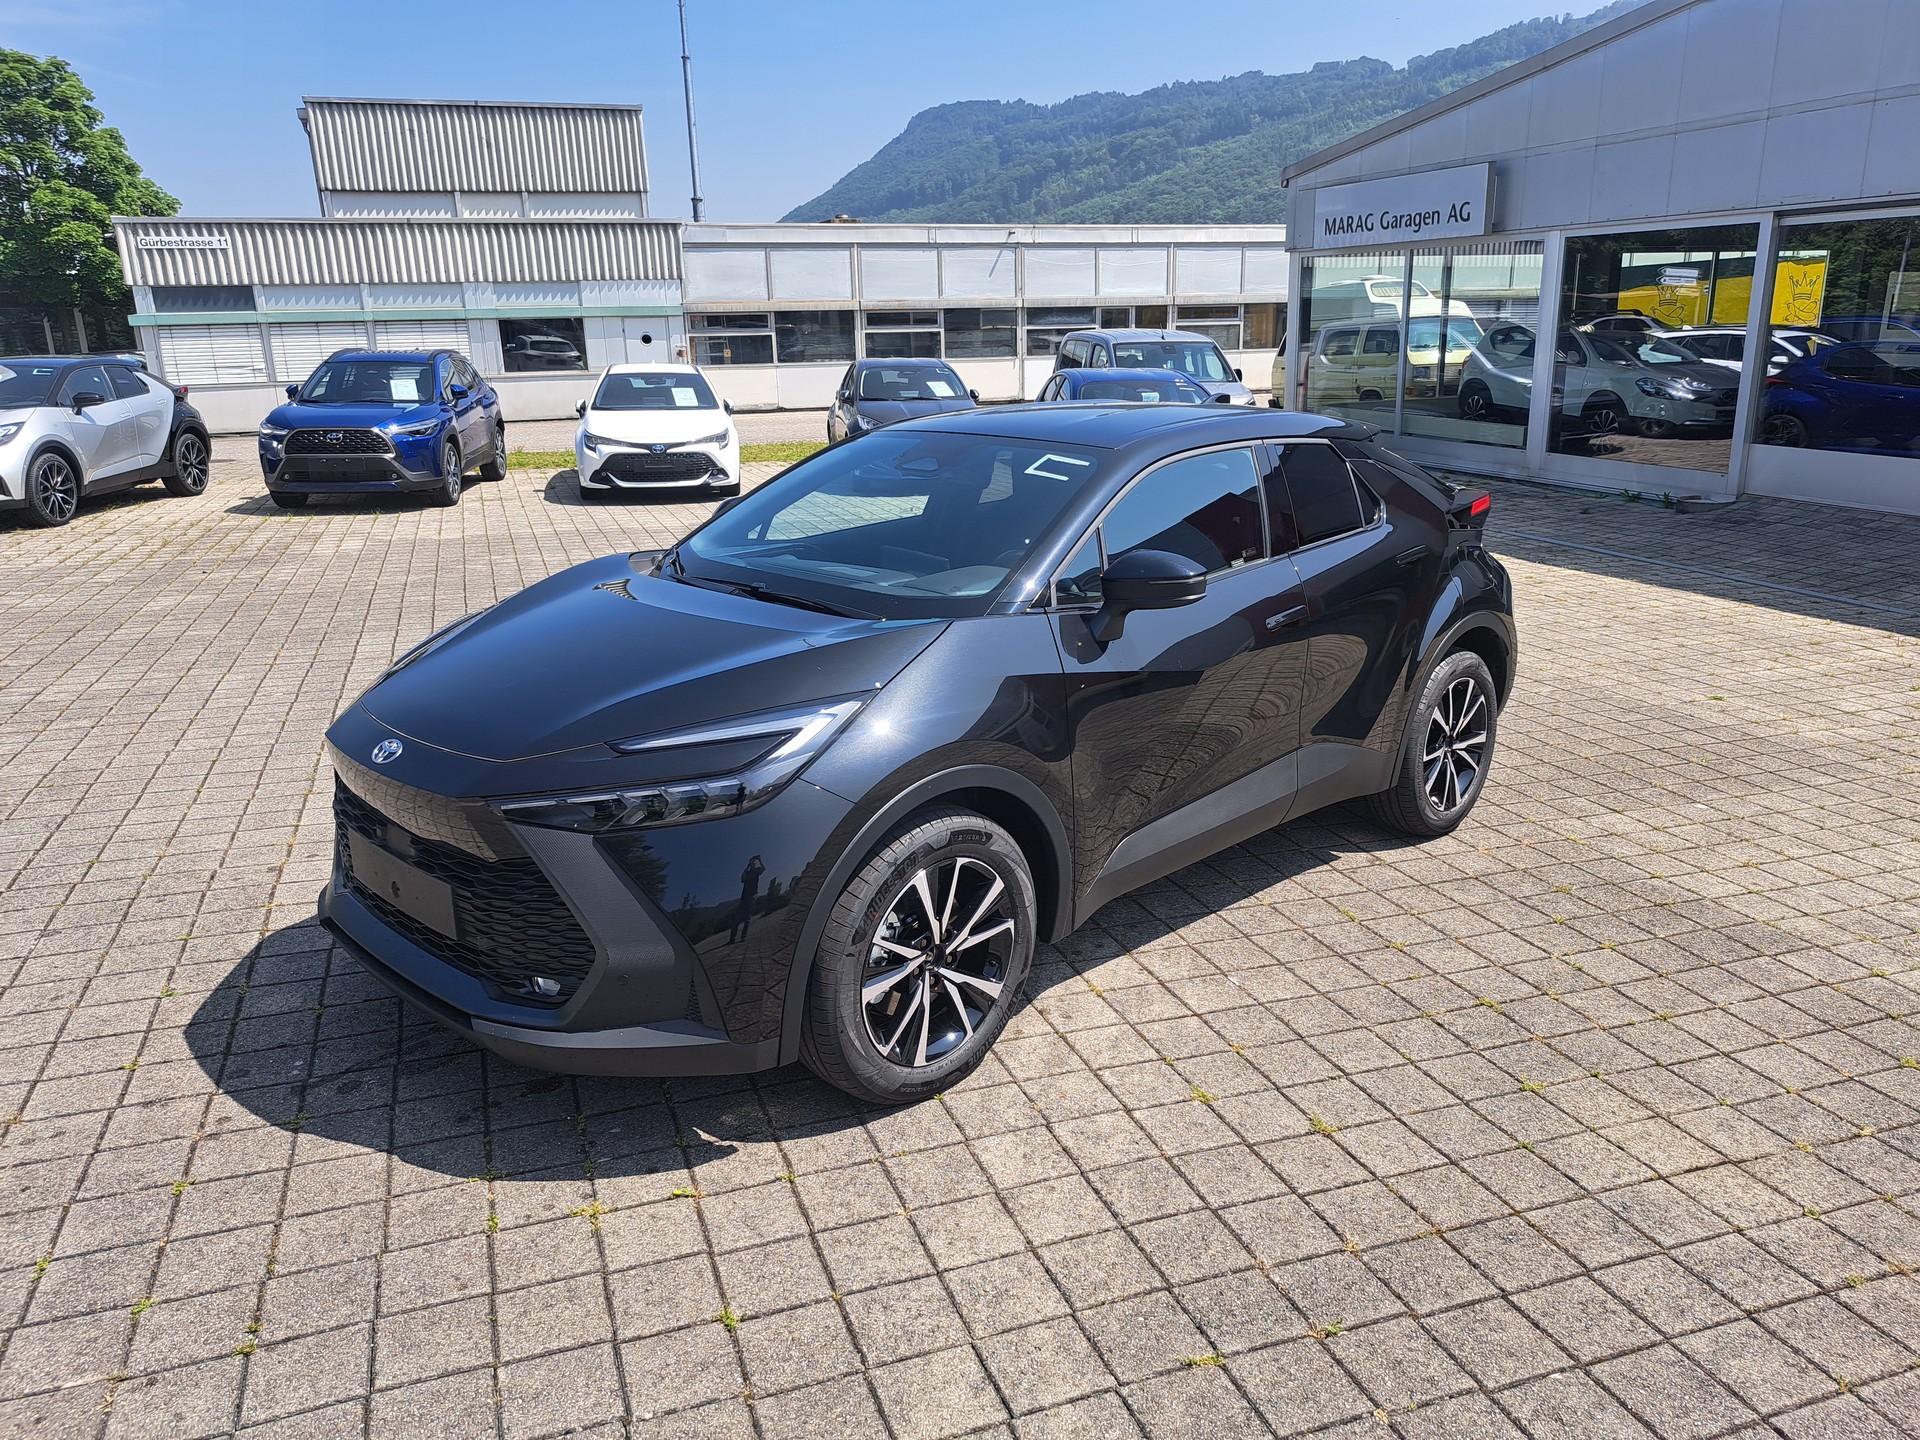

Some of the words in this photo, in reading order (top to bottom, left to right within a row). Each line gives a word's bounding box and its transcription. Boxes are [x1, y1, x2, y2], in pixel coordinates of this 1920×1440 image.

[1324, 212, 1374, 236] MARAG
[1380, 209, 1440, 233] Garagen
[1447, 201, 1471, 224] AG
[139, 238, 214, 247] Gürbestrasse
[217, 238, 229, 247] 11
